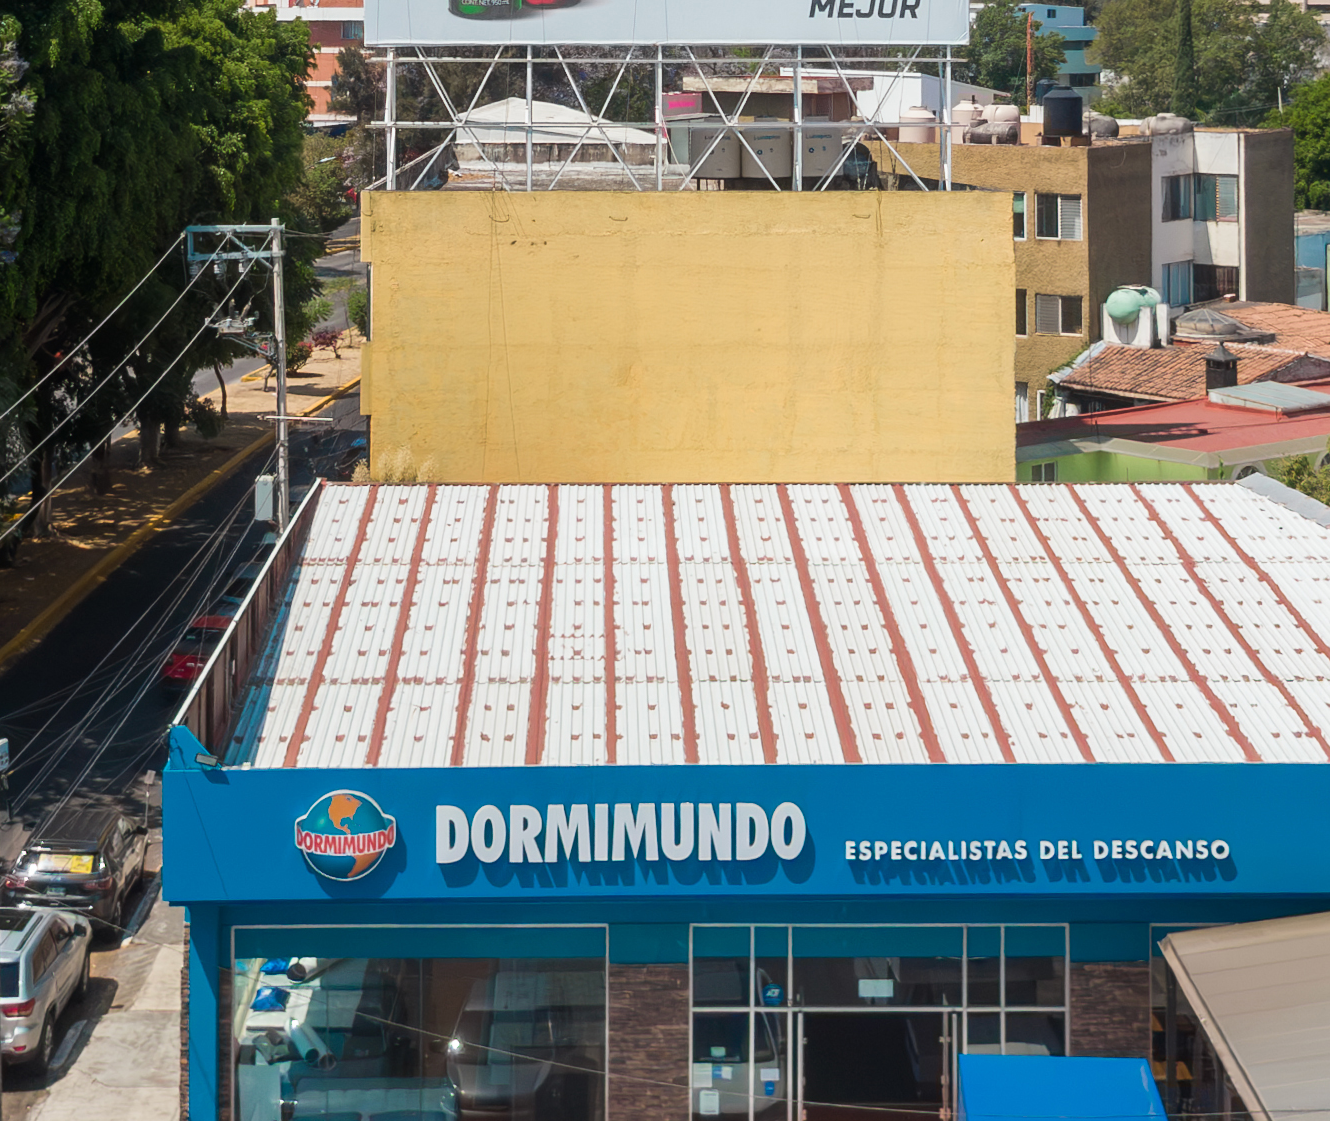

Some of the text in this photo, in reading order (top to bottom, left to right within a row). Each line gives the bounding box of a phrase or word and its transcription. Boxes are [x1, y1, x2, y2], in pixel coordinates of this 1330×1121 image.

[296, 825, 395, 855] DORMIMUNDO
[435, 802, 807, 864] DORMIMUNDO
[844, 839, 1231, 861] ESPECIALISTAS DEL DESCANSO
